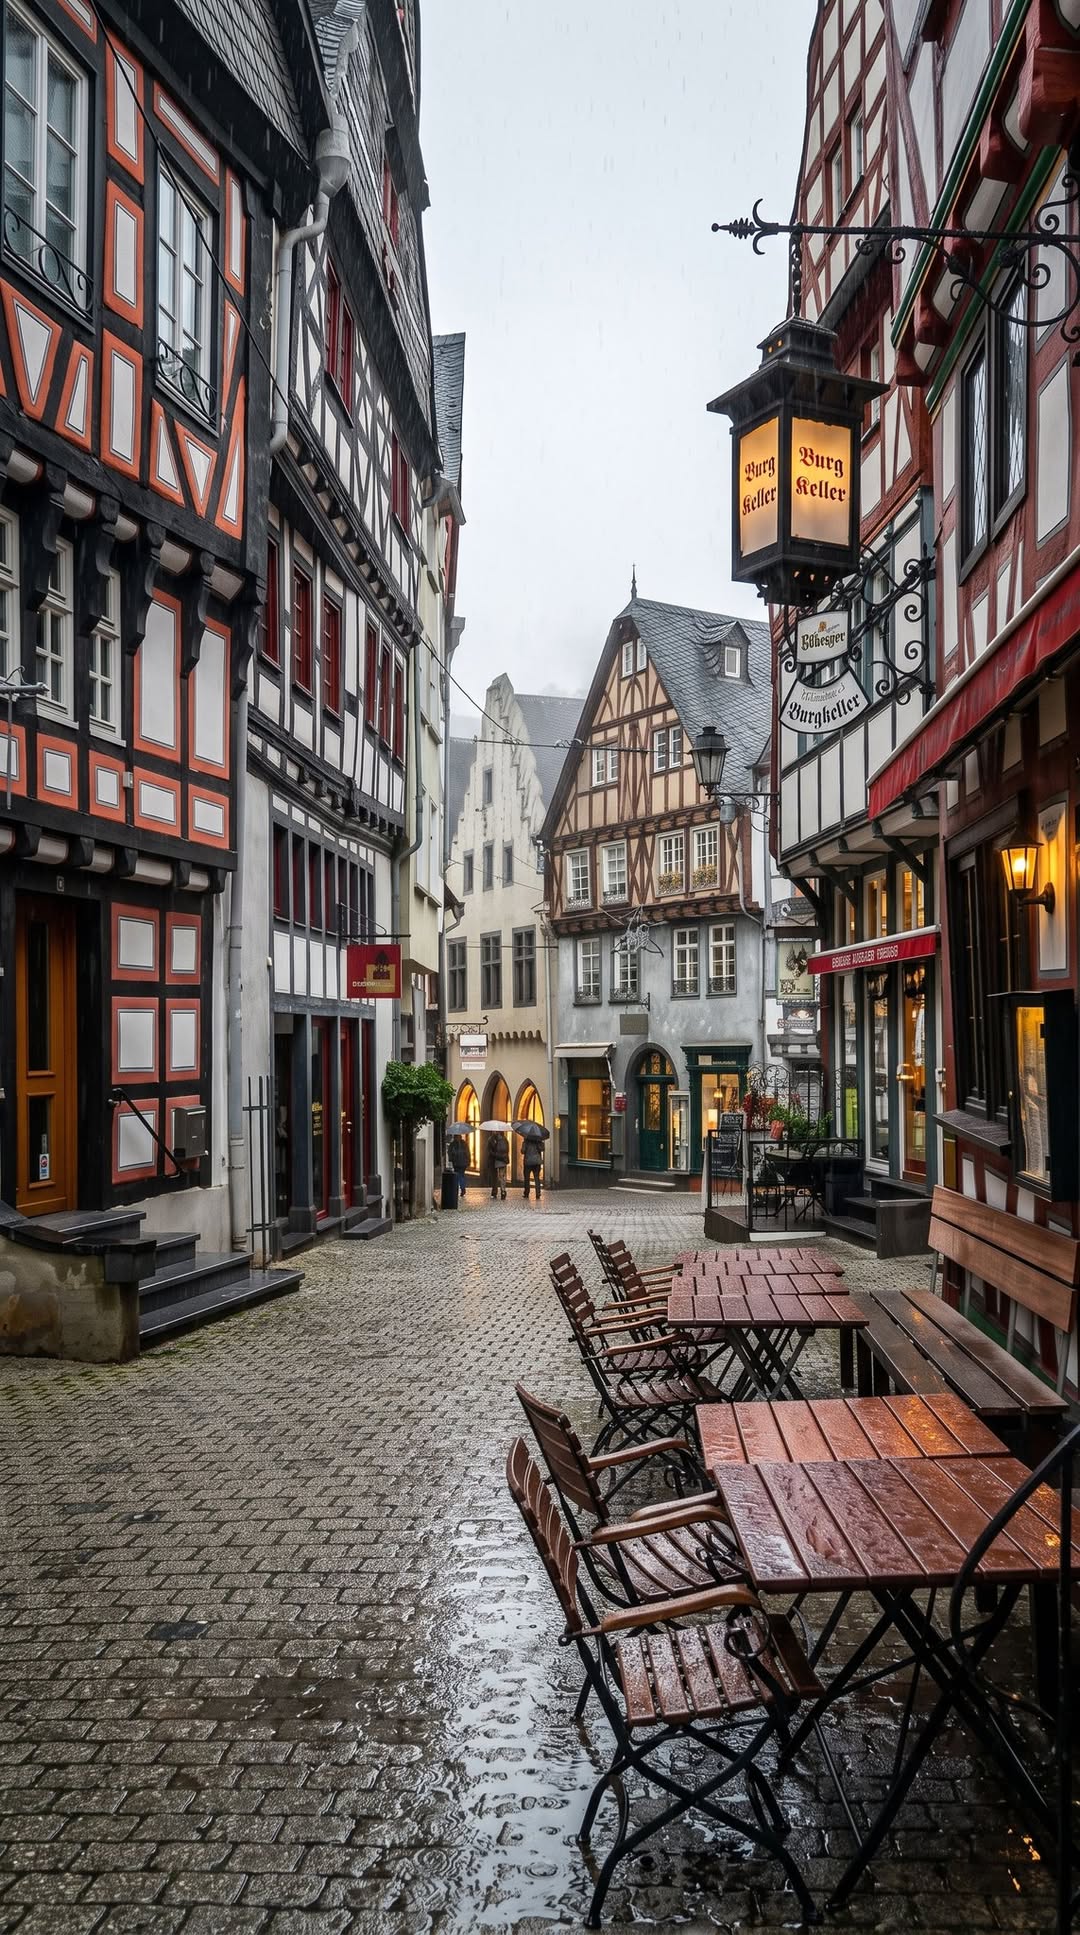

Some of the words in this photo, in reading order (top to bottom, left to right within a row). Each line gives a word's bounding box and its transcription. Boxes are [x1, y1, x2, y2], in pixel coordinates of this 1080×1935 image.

[744, 456, 775, 482] Burg
[798, 446, 844, 479] Burg
[742, 486, 777, 516] Keller
[795, 475, 846, 502] Keller
[787, 694, 861, 730] Burgkeller
